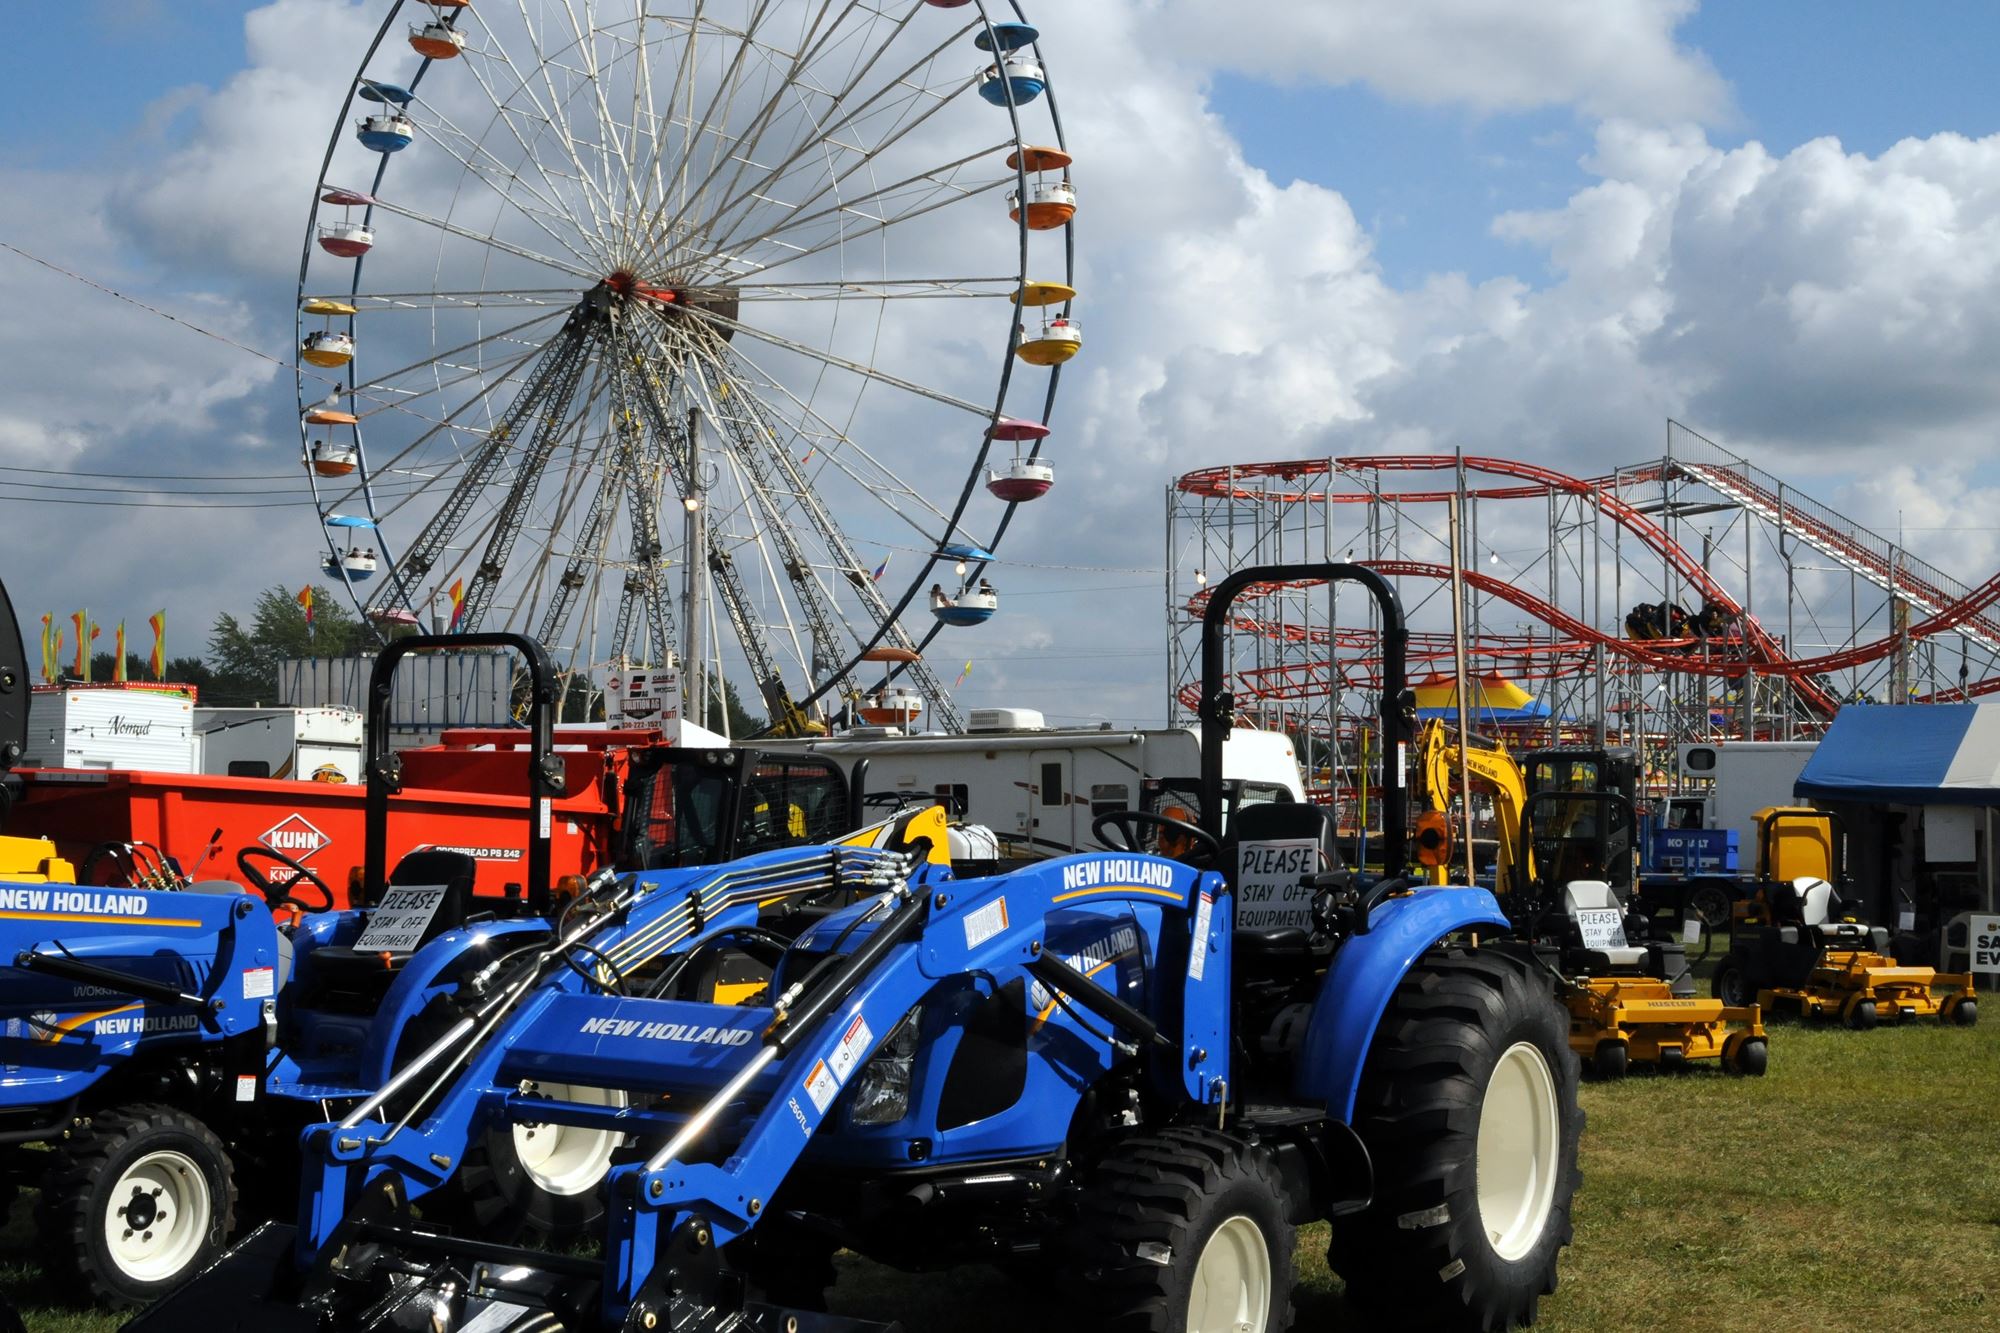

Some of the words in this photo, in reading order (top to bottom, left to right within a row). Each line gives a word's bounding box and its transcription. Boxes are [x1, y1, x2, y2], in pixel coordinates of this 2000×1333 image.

[109, 715, 152, 736] Nomad
[271, 831, 319, 849] KUHN
[1667, 838, 1708, 848] KOLT
[490, 849, 501, 857] PS
[503, 849, 520, 858] 242
[1242, 849, 1313, 874] PLEASE
[270, 870, 317, 881] KNI
[1063, 861, 1100, 890] NEW
[1104, 860, 1172, 888] HOLLAND
[381, 892, 441, 910] PLEASE
[1243, 884, 1275, 902] STAY
[1283, 884, 1309, 901] OFF
[0, 889, 49, 911] NEW
[53, 891, 148, 916] HOLLAND
[370, 916, 400, 929] STAY
[401, 916, 427, 929] OFF
[1238, 910, 1312, 928] EQUIPMENT
[1581, 913, 1617, 924] PLEASE
[357, 934, 419, 946] EQUIPMENT
[1607, 928, 1620, 936] OFF
[1083, 927, 1135, 973] HOLLAND
[95, 1018, 131, 1035] NEW
[133, 1015, 199, 1033] HOLLAND
[580, 1017, 642, 1037] NEW
[637, 1022, 753, 1046] HOLLAND
[788, 1097, 813, 1138] 260TLA
